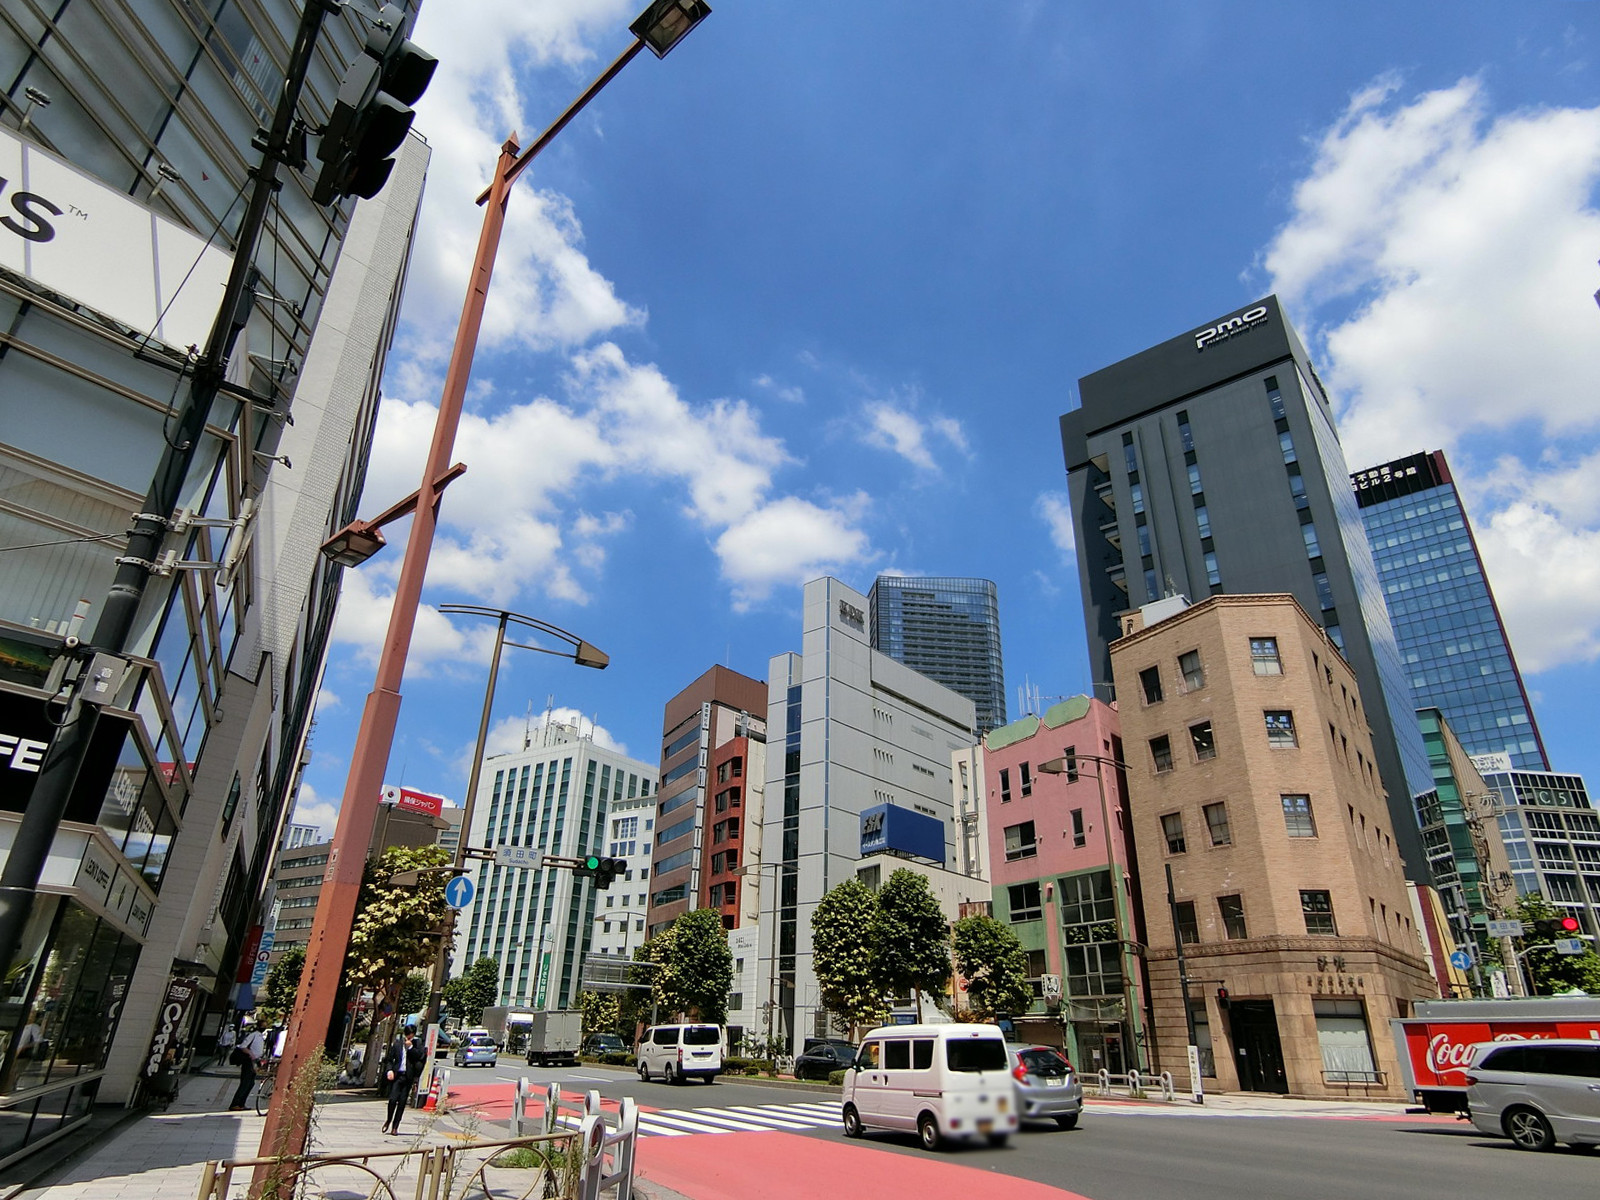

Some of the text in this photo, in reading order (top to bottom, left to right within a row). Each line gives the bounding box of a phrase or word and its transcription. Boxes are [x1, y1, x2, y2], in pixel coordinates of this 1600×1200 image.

[503, 848, 537, 860] 須田町
[250, 932, 275, 985] KINGRUN
[1426, 1033, 1476, 1073] Coca
